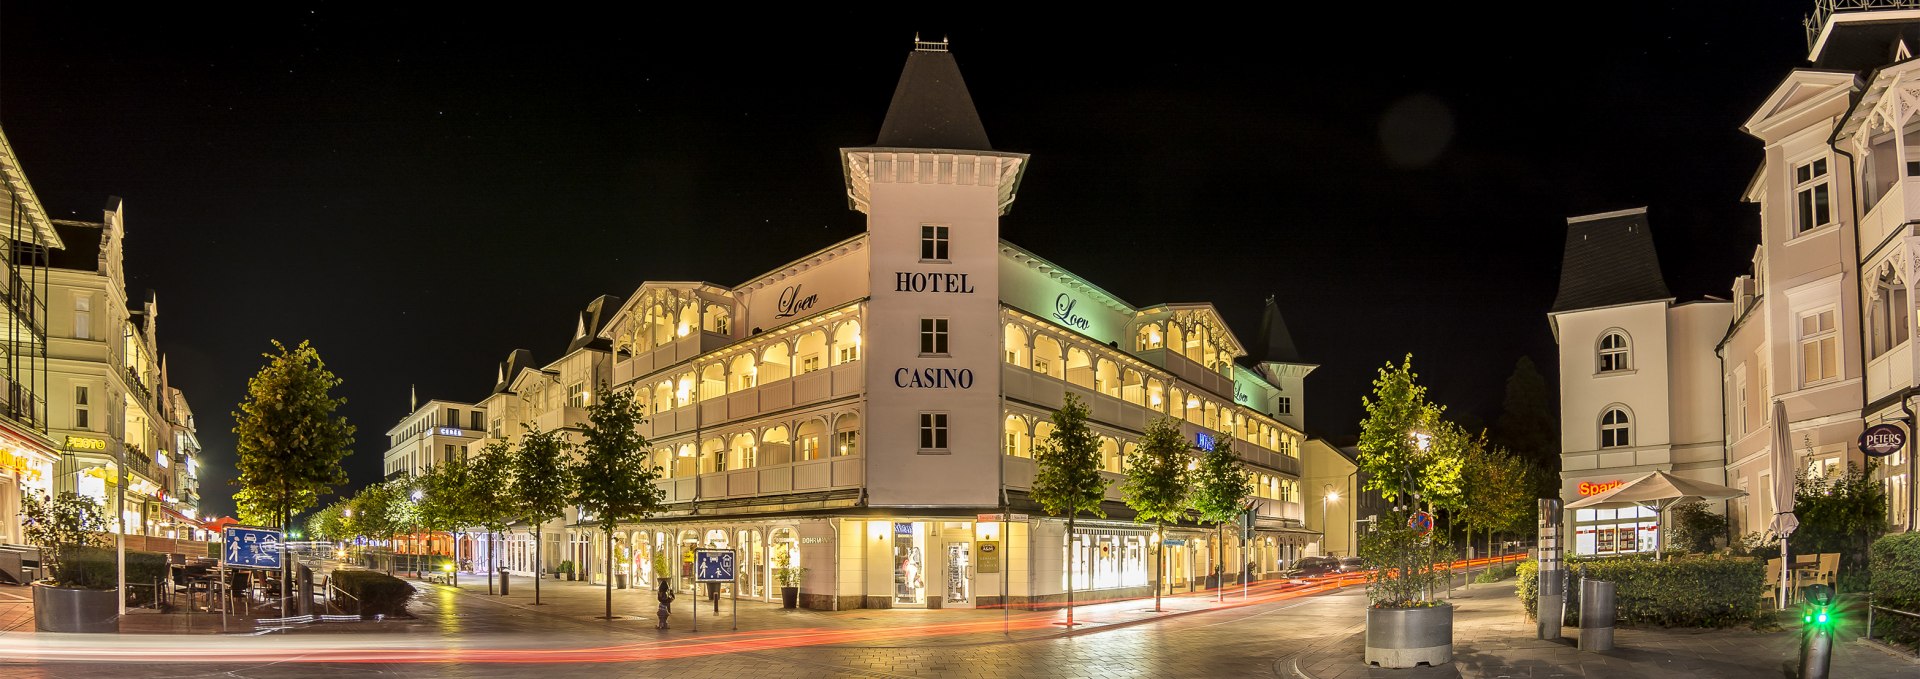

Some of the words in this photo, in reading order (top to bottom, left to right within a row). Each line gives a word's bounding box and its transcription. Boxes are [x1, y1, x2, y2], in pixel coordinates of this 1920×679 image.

[895, 272, 974, 293] HOTEL
[775, 284, 818, 319] Loev
[1053, 293, 1090, 330] Loev
[895, 368, 973, 389] CASINO
[67, 436, 106, 450] PHOTO
[1866, 433, 1901, 446] PETERS
